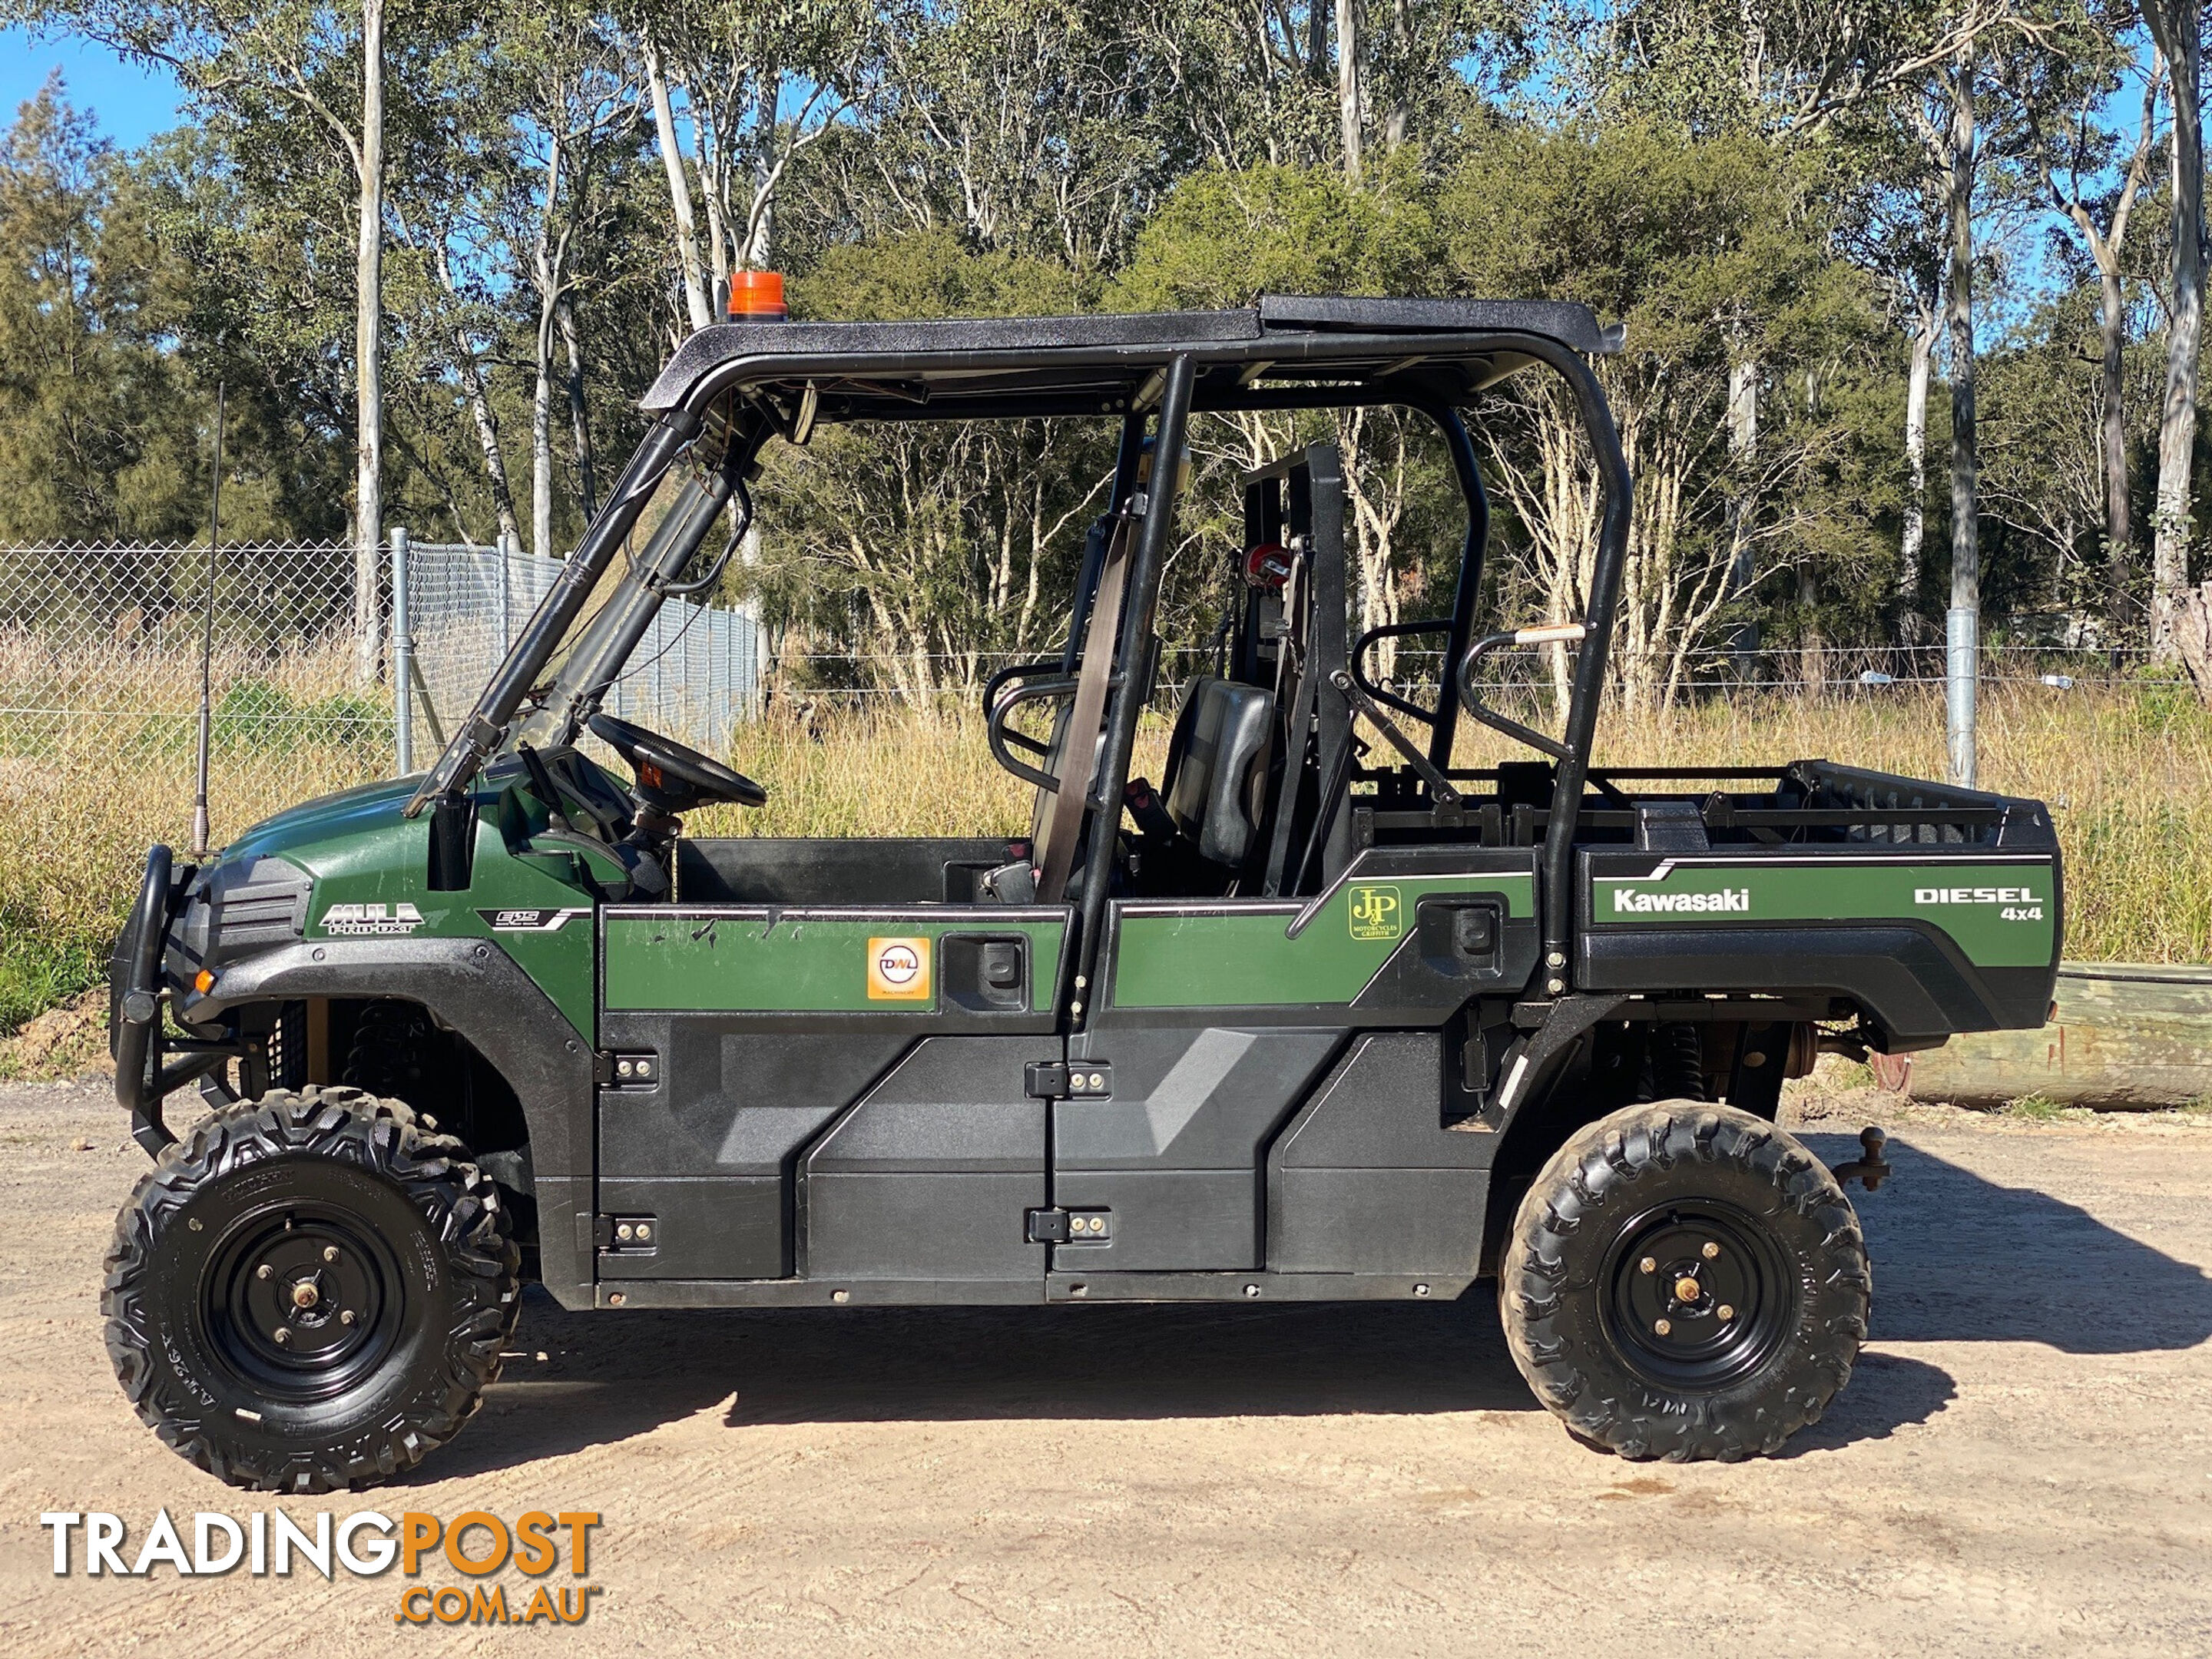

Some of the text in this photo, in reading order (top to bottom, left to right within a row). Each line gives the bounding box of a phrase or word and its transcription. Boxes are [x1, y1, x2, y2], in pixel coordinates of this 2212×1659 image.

[1614, 889, 1749, 912] Kawasaki
[1915, 888, 2043, 903] DIESEL
[319, 903, 426, 926] MULE
[2001, 907, 2043, 920] 4x4
